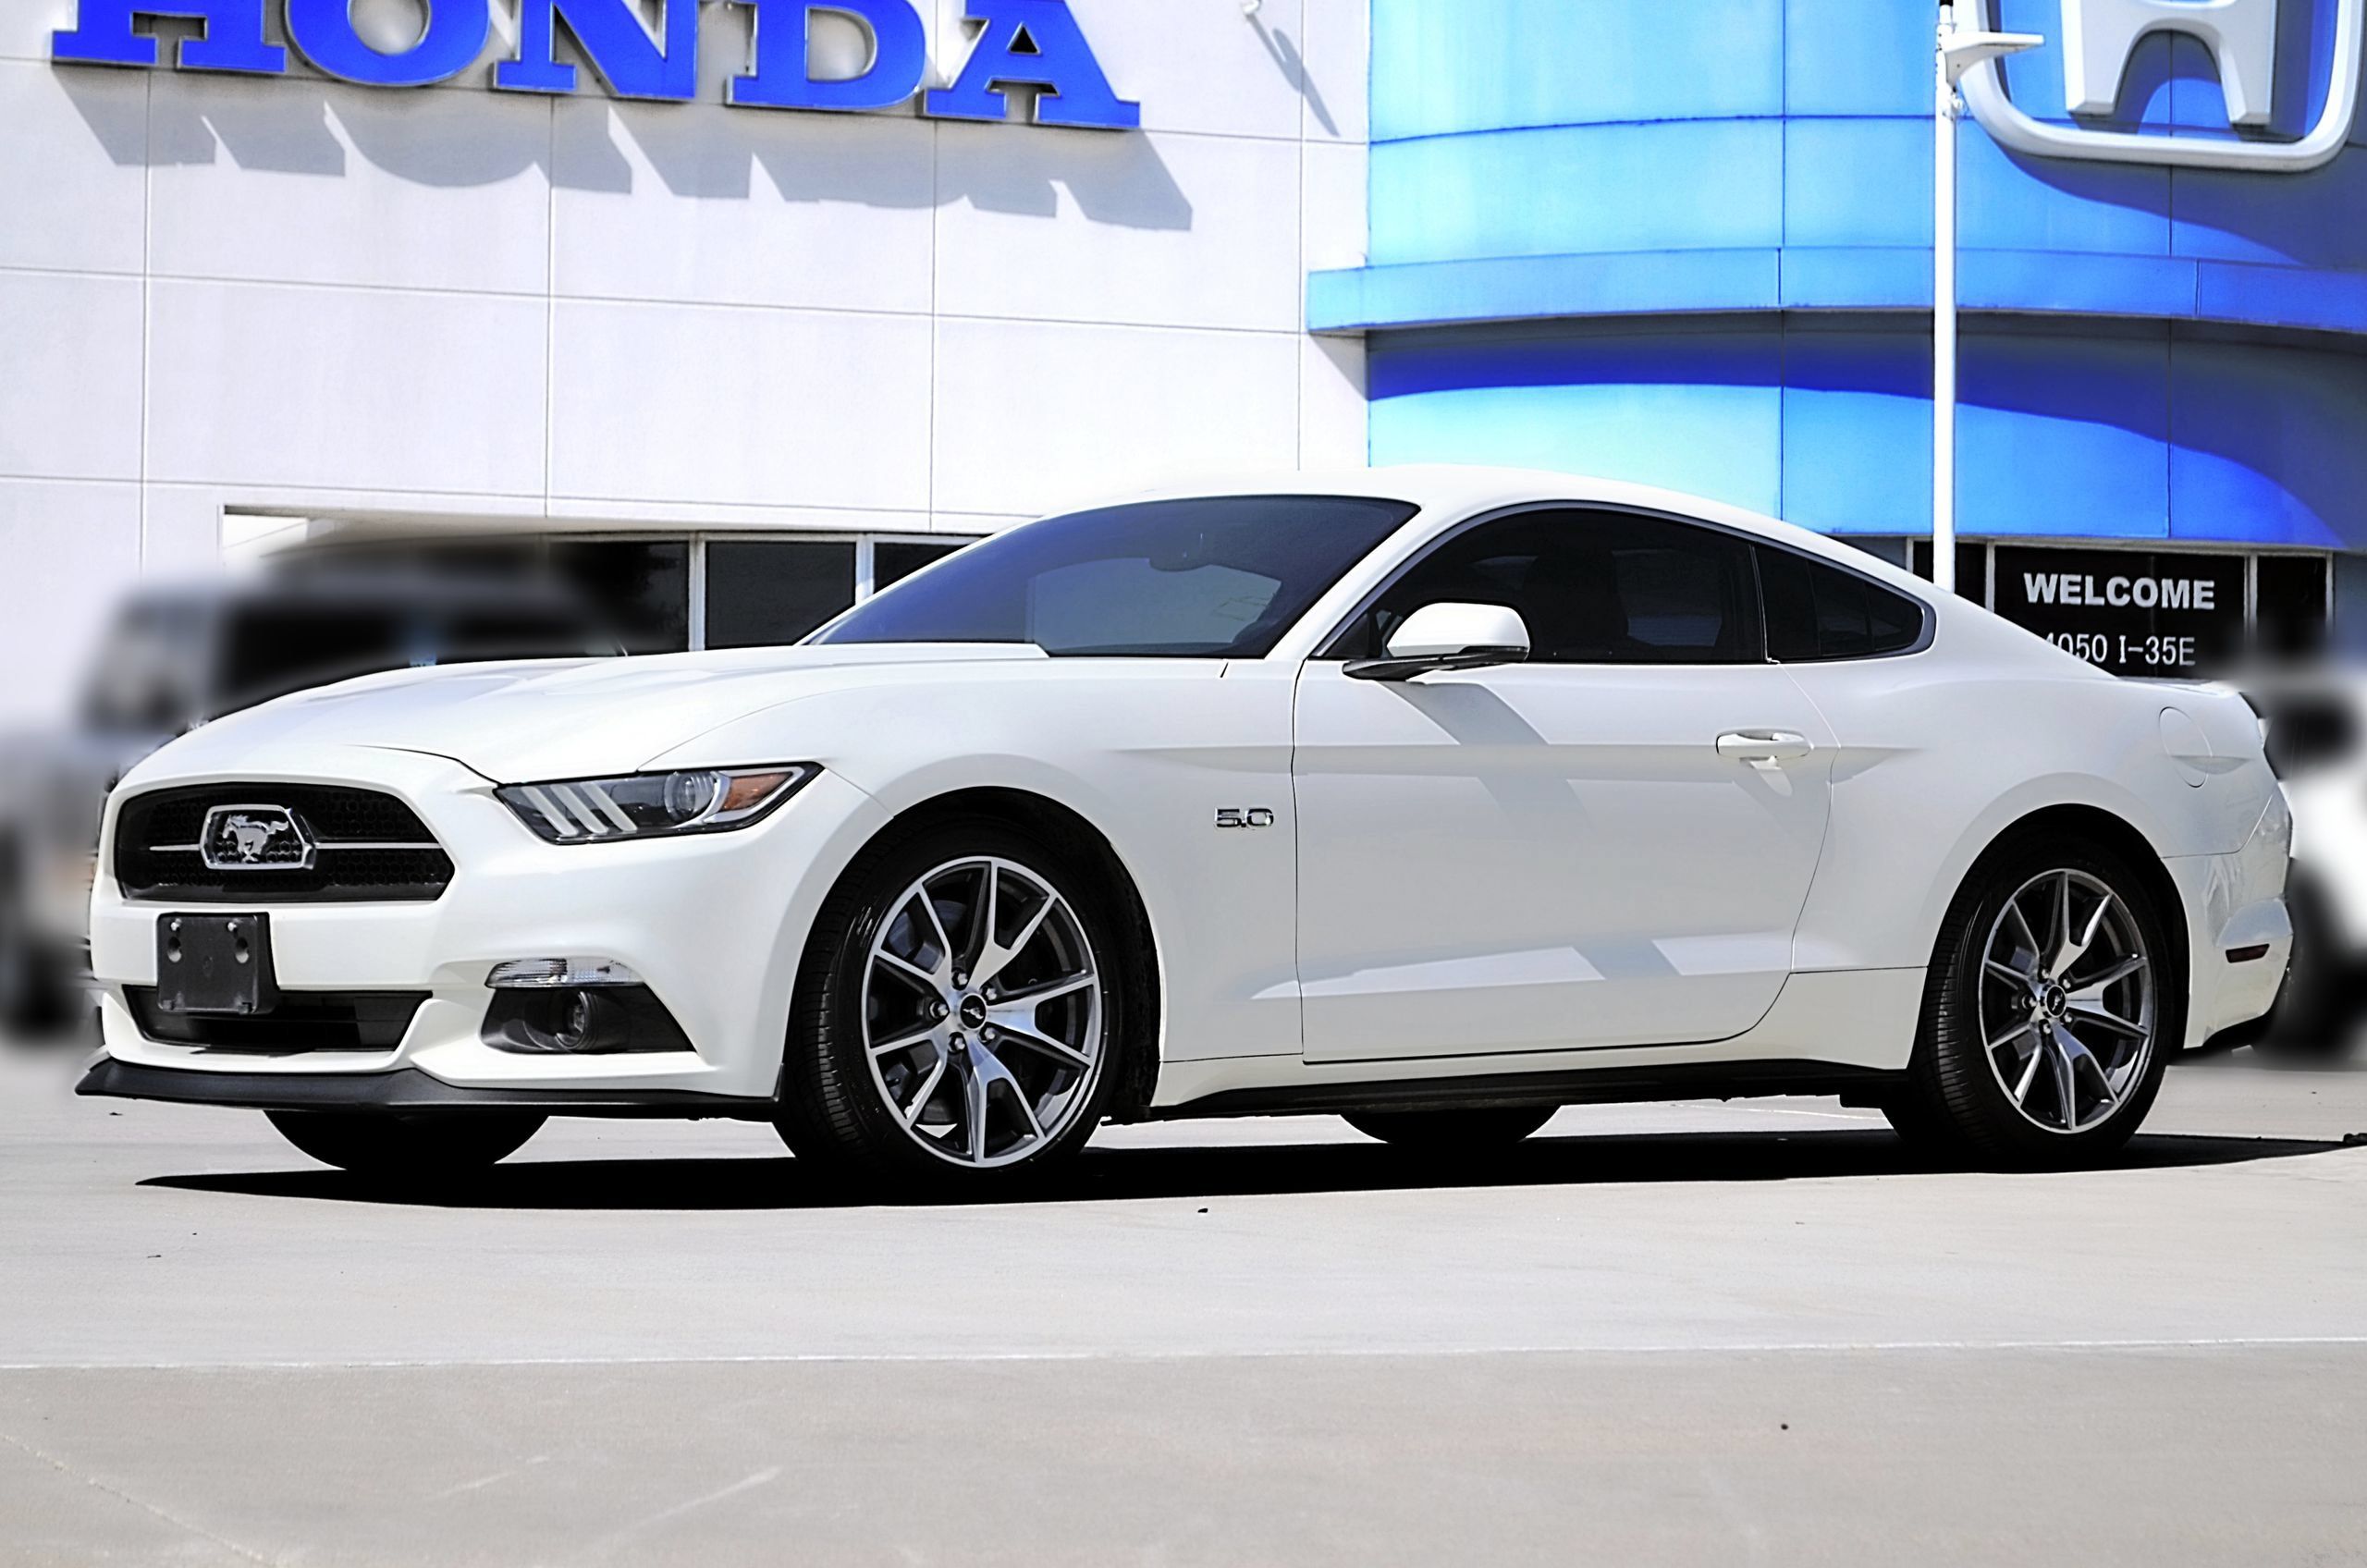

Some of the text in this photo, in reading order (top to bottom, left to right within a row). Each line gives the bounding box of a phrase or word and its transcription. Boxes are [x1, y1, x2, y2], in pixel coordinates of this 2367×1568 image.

[52, 0, 1141, 129] HONDA
[2023, 572, 2215, 610] WELCOME
[2118, 634, 2196, 666] I-35E
[1214, 807, 1274, 828] 5.0
